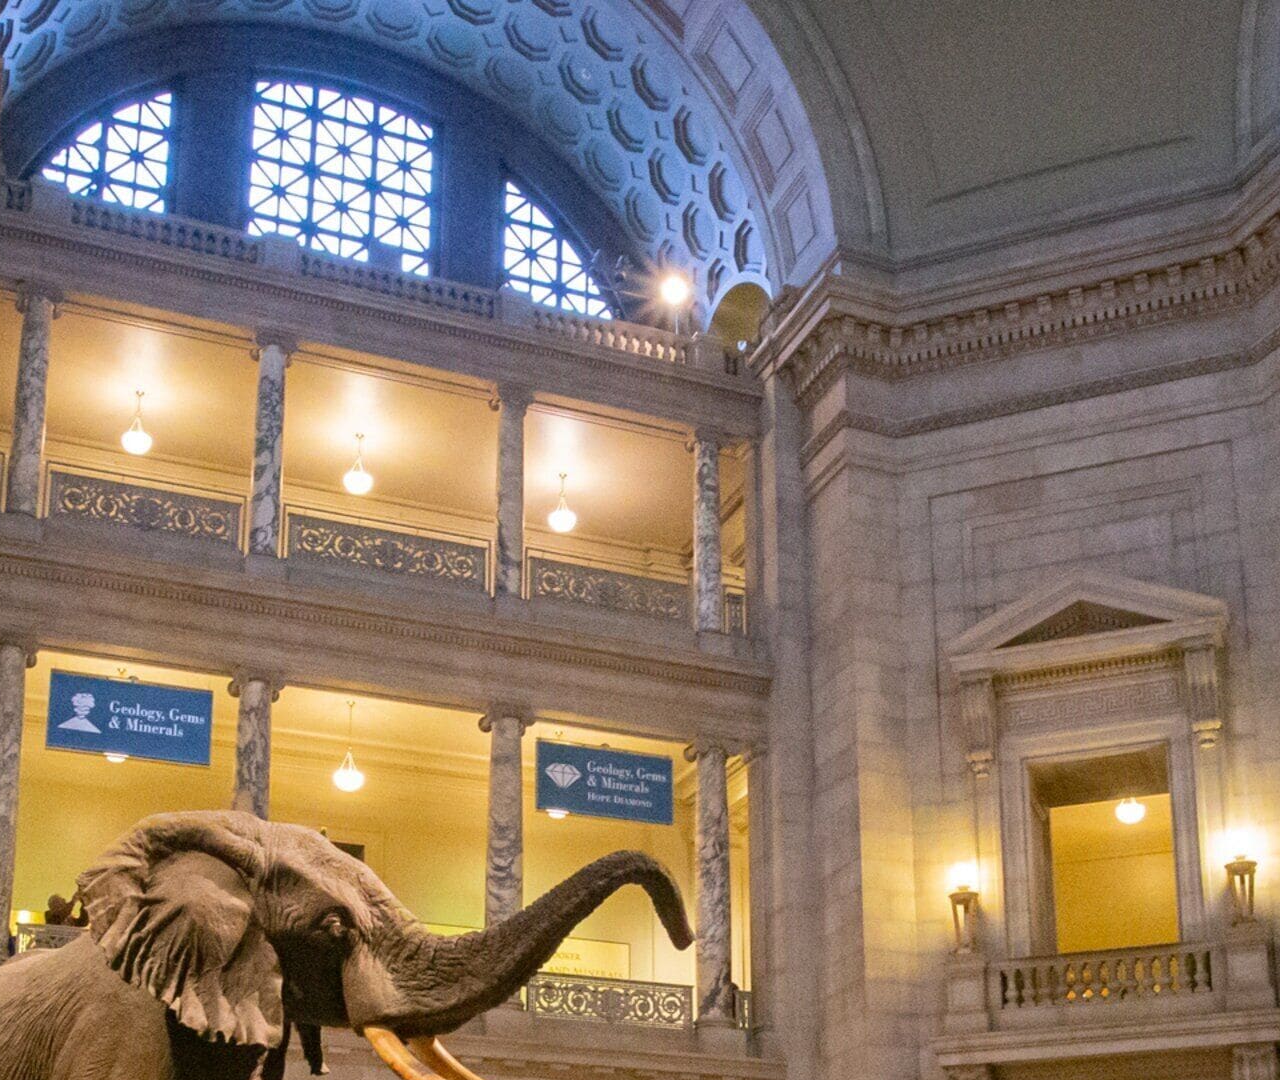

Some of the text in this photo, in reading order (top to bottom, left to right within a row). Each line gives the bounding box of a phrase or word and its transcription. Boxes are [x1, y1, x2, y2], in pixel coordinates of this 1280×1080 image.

[109, 700, 205, 725] Geology, Gems
[108, 716, 184, 738] & Minerals
[586, 760, 667, 783] Geology, Gems
[586, 774, 650, 794] & Minerals
[587, 792, 653, 808] HOPE DIAMOND
